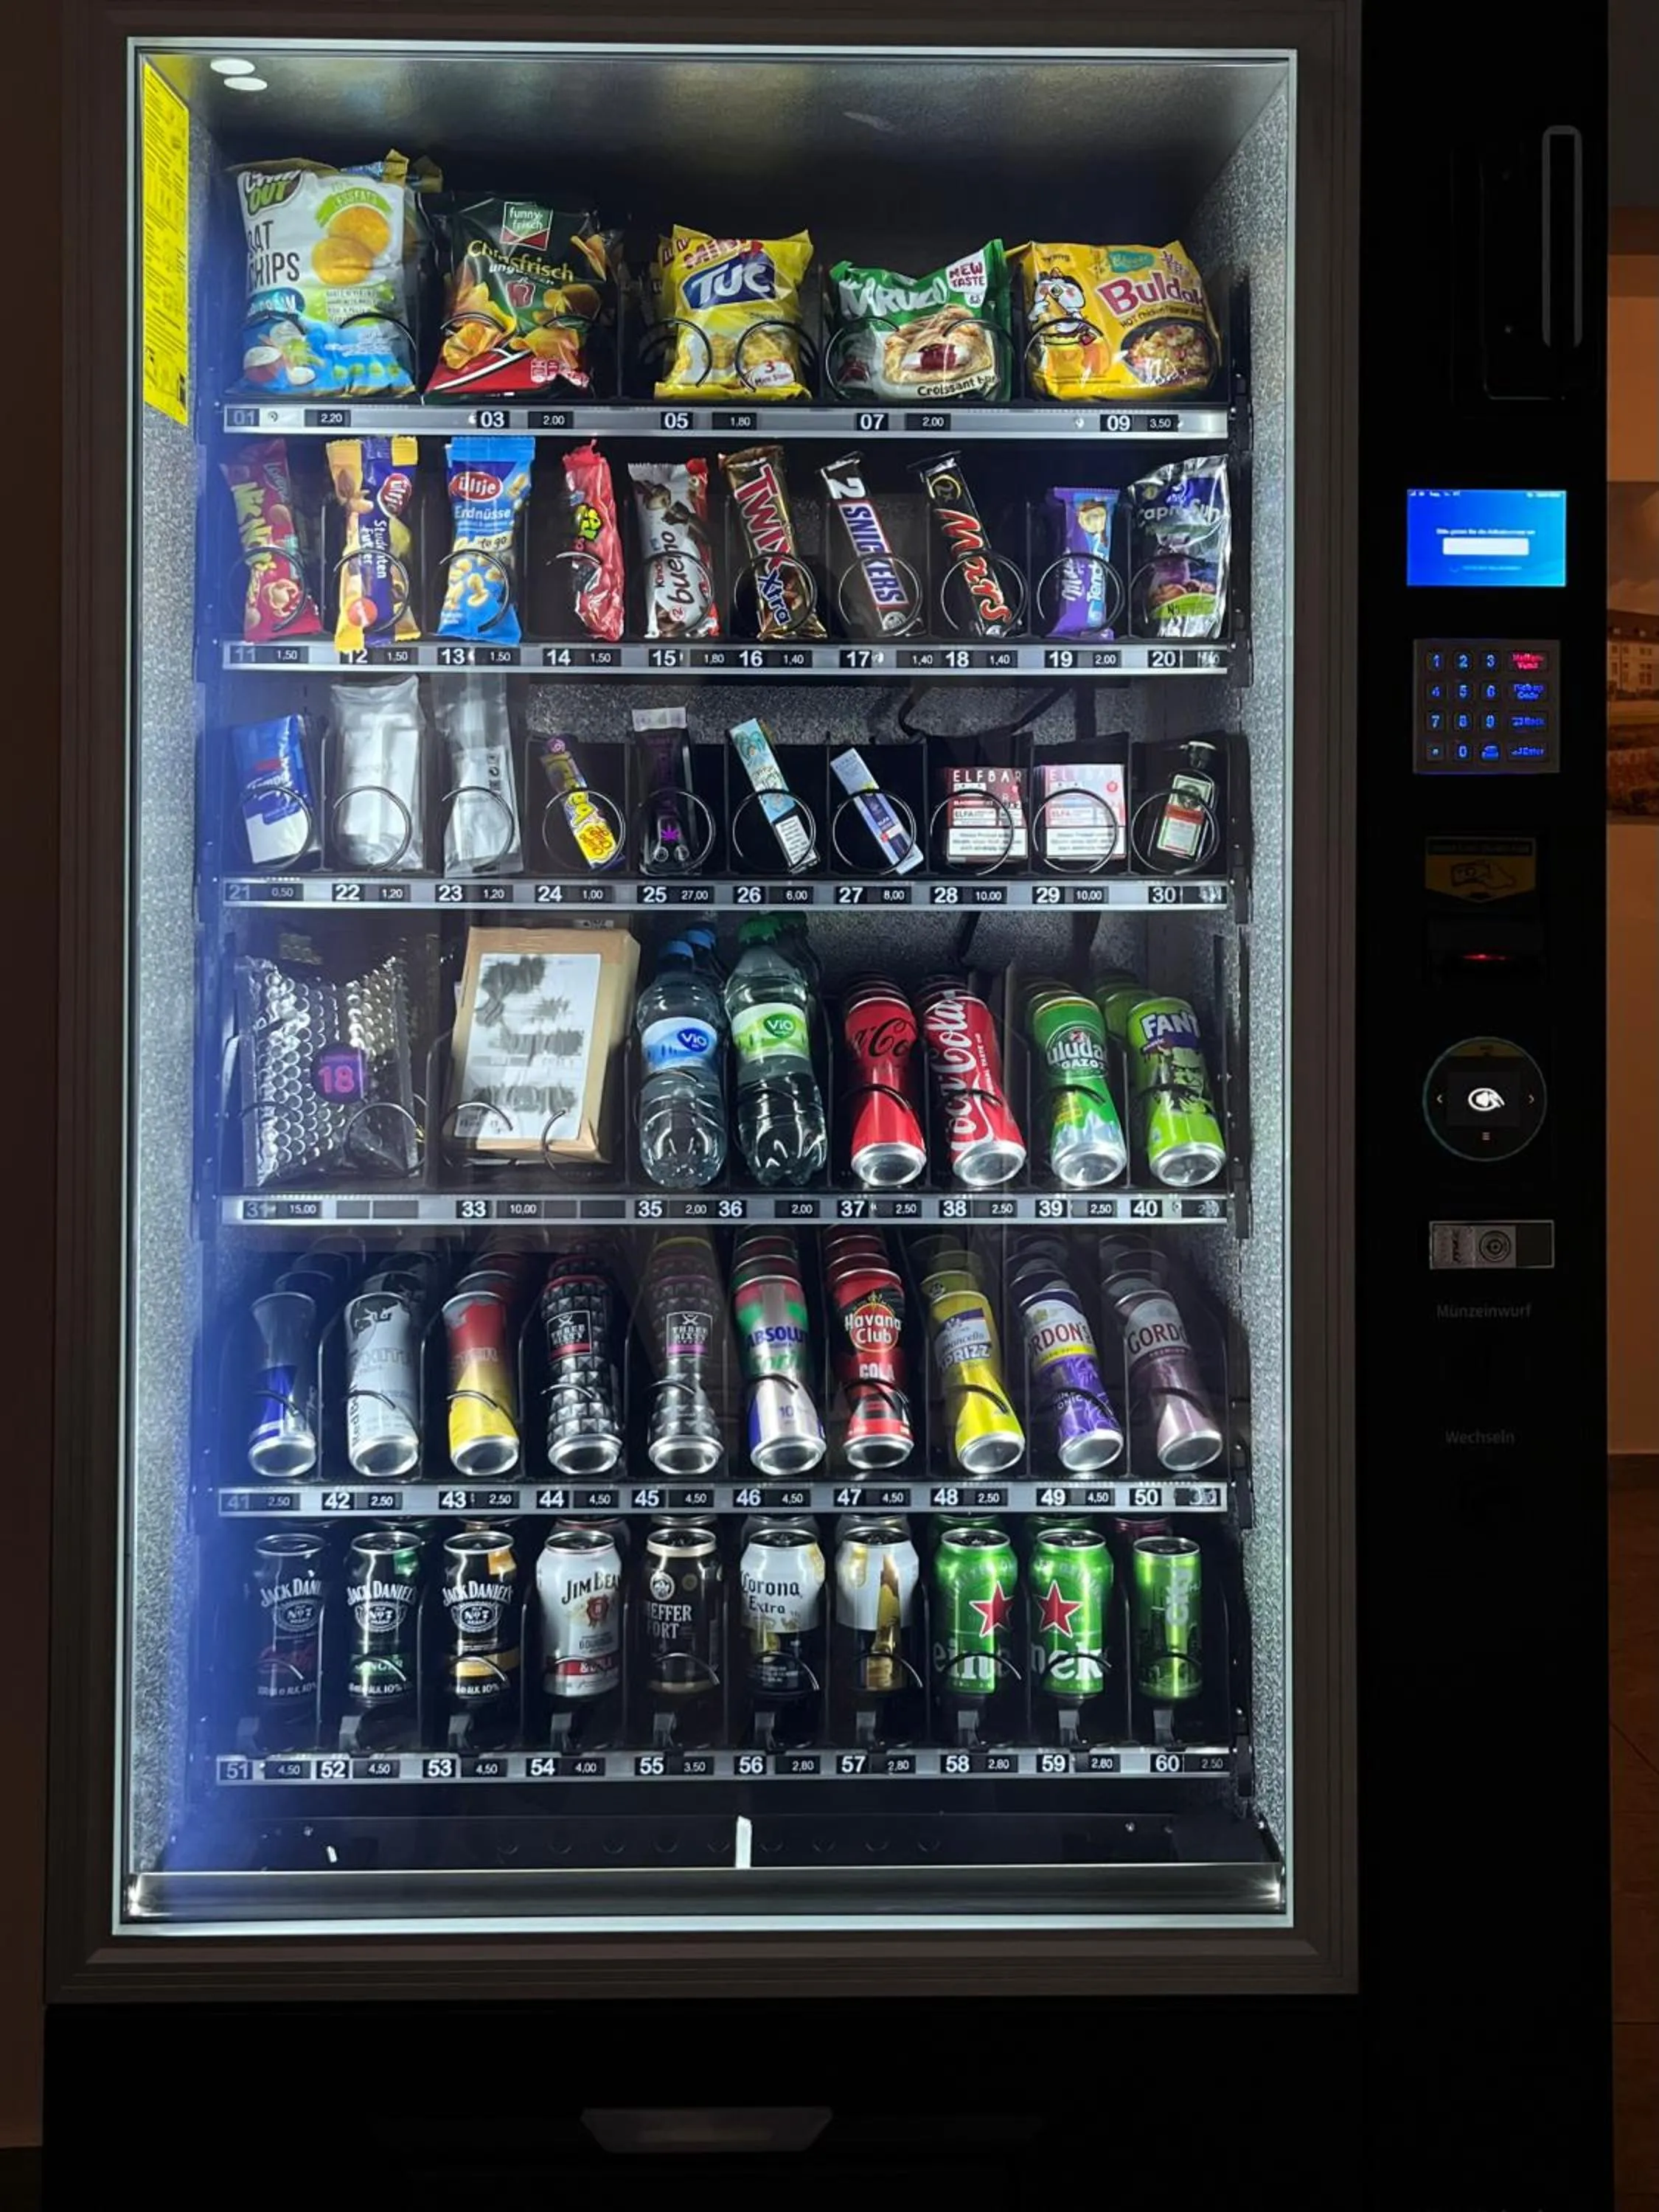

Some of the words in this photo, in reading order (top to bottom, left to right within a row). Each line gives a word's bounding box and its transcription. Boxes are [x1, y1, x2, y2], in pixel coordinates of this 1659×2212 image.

[948, 261, 984, 279] NEW
[691, 260, 771, 304] TUC
[950, 274, 986, 288] TASTE
[917, 376, 975, 397] Croissant
[481, 411, 504, 428] 03
[664, 414, 689, 428] 05
[860, 414, 883, 430] 07
[1107, 416, 1130, 431] 09
[454, 505, 511, 520] Erdnüsse
[734, 463, 796, 571] TWIX
[345, 649, 367, 663] 12
[442, 649, 465, 664] 13
[547, 650, 571, 664] 14
[653, 650, 676, 665] 15
[740, 651, 763, 666] 16
[846, 652, 870, 666] 17
[945, 652, 969, 667] 18
[1049, 652, 1073, 667] 19
[1152, 652, 1176, 667] 20
[1433, 654, 1440, 667] 1
[1458, 654, 1468, 668] 2
[1486, 654, 1495, 667] 3
[1431, 686, 1440, 697] 4
[1459, 684, 1469, 698] 5
[1486, 684, 1495, 698] 6
[1431, 714, 1440, 728] 7
[1459, 714, 1468, 728] 8
[1486, 714, 1495, 728] 9
[1458, 745, 1467, 758] 0
[229, 886, 249, 900] 21
[335, 886, 359, 900] 22
[439, 886, 462, 901] 23
[538, 886, 562, 901] 24
[644, 888, 667, 902] 25
[737, 888, 761, 902] 26
[839, 888, 863, 903] 27
[934, 888, 958, 903] 28
[1036, 888, 1060, 903] 29
[1152, 887, 1176, 902] 30
[1141, 1011, 1200, 1038] FANT
[318, 1065, 355, 1093] 18
[462, 1202, 486, 1217] 33
[639, 1202, 662, 1217] 35
[719, 1202, 742, 1217] 36
[841, 1202, 864, 1217] 37
[943, 1202, 967, 1217] 38
[1039, 1201, 1062, 1217] 39
[1133, 1201, 1157, 1217] 40
[1436, 1303, 1532, 1319] Münzeinwurf
[844, 1312, 902, 1333] Havana
[855, 1329, 892, 1345] Club
[1444, 1429, 1515, 1445] Wechseln
[227, 1495, 249, 1510] 41
[325, 1494, 350, 1509] 42
[442, 1492, 466, 1507] 43
[540, 1490, 564, 1506] 44
[635, 1490, 659, 1506] 45
[737, 1490, 761, 1506] 46
[838, 1489, 862, 1505] 47
[933, 1489, 958, 1505] 48
[1041, 1489, 1065, 1505] 49
[1135, 1489, 1158, 1505] 50
[562, 1576, 592, 1605] JIM
[742, 1571, 801, 1599] Corona
[748, 1596, 786, 1615] Extra
[226, 1763, 248, 1778] 51
[321, 1762, 346, 1778] 52
[428, 1759, 452, 1775] 53
[531, 1759, 554, 1775] 54
[639, 1758, 664, 1775] 55
[740, 1757, 763, 1774] 56
[841, 1756, 866, 1773] 57
[945, 1756, 970, 1773] 58
[1042, 1756, 1065, 1772] 59
[1155, 1756, 1180, 1772] 60
